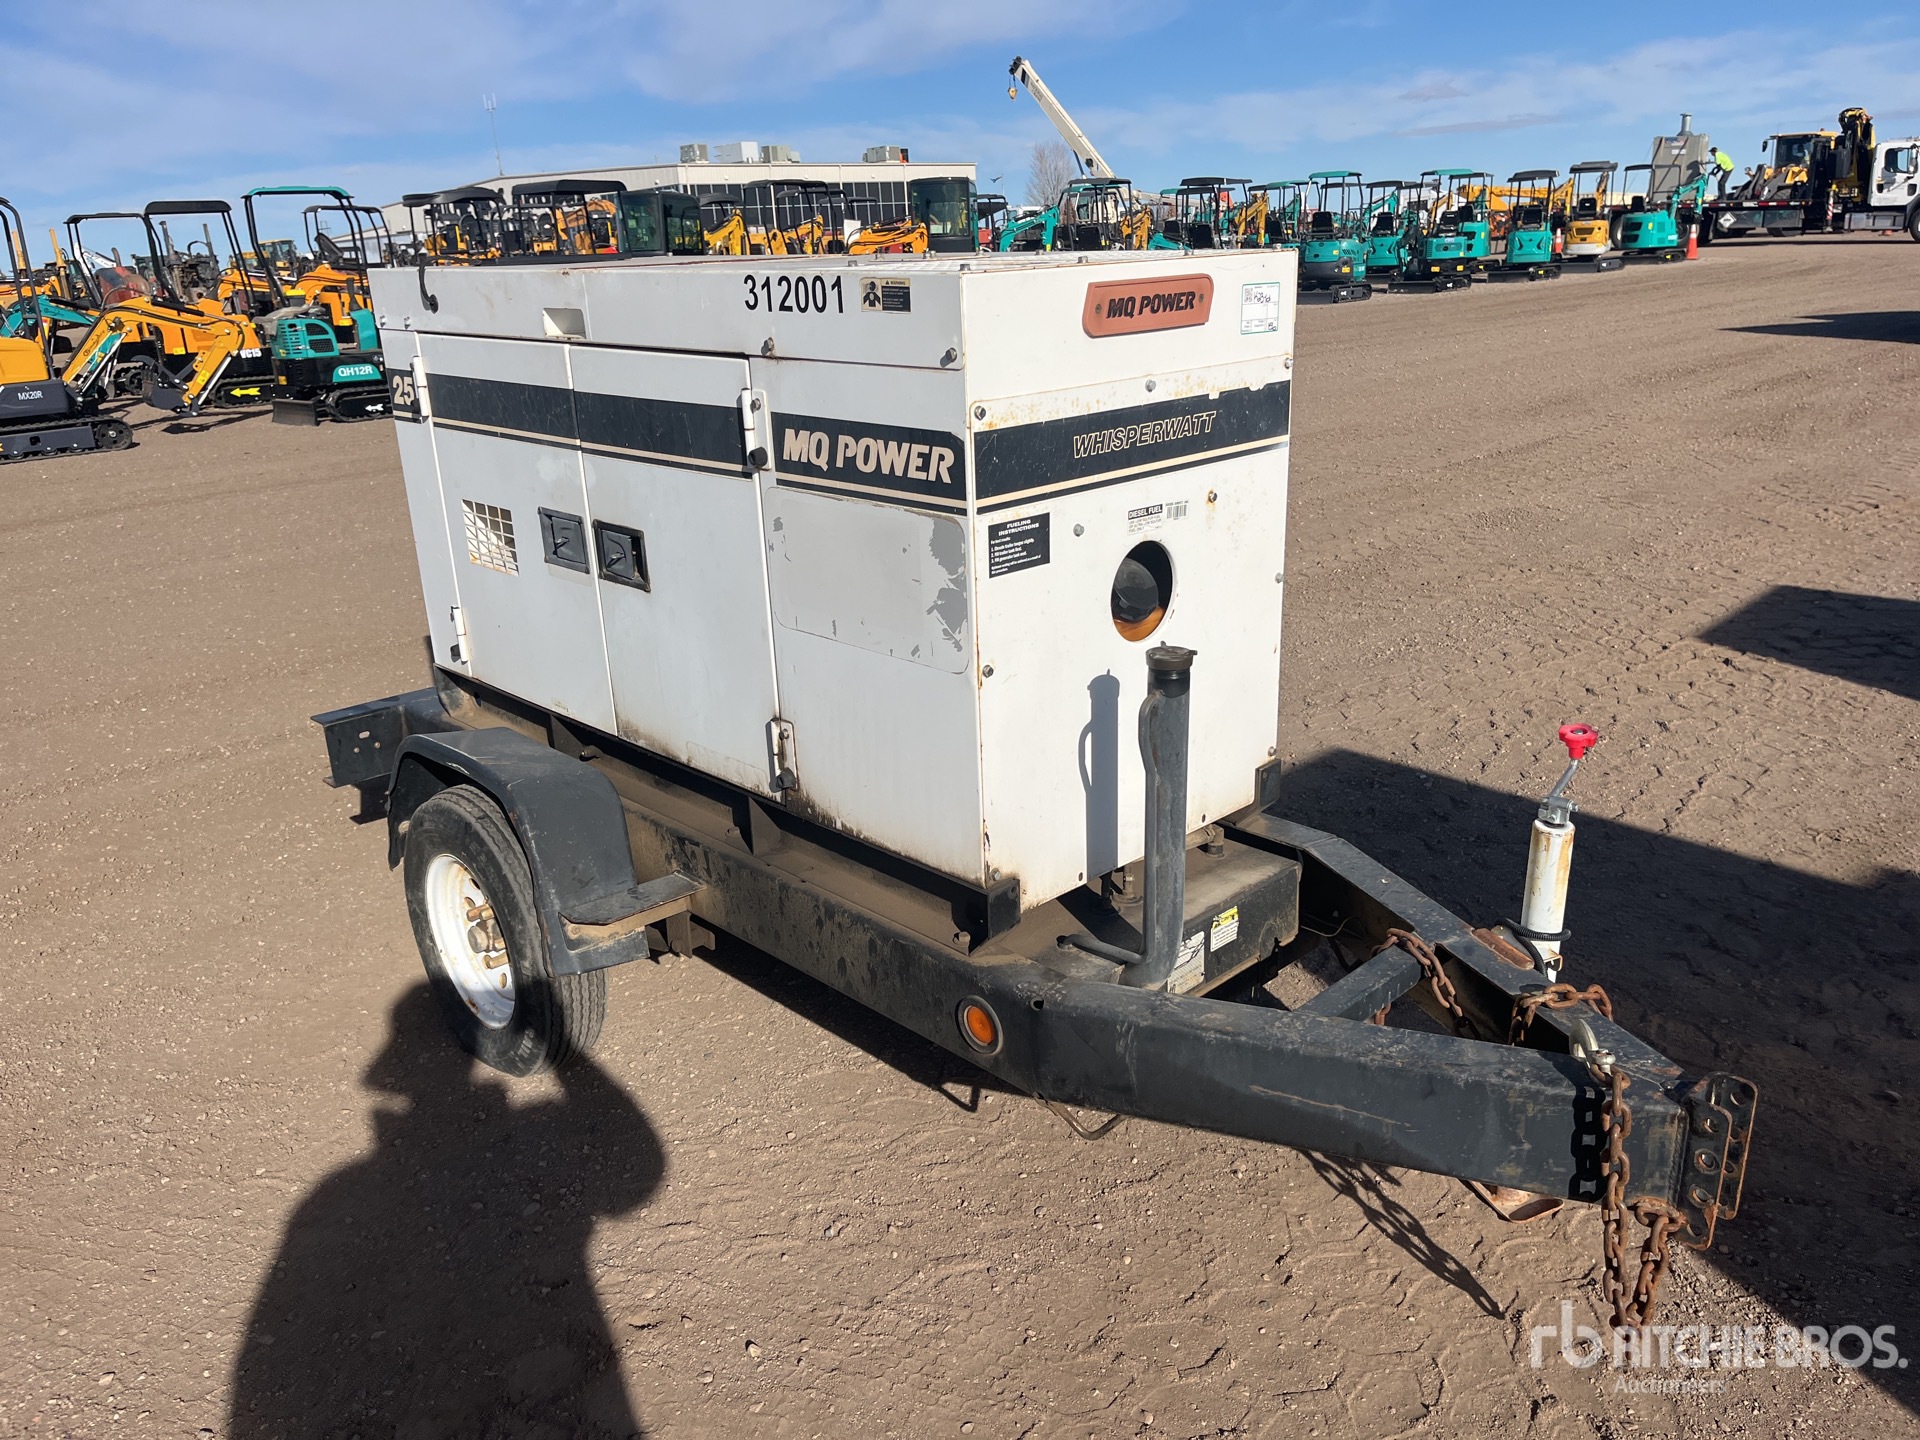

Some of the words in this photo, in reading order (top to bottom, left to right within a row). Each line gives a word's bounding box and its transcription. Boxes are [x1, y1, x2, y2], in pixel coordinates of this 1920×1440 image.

[743, 274, 843, 313] 312001
[1106, 296, 1136, 319] MQ
[1138, 291, 1196, 316] POWER
[338, 365, 373, 377] QH12R
[17, 390, 43, 400] MX20R
[392, 375, 415, 406] 25
[1073, 410, 1216, 459] WHISPERWATT
[782, 428, 830, 472] MQ
[835, 434, 955, 484] POWER
[1128, 509, 1148, 518] DIESEL
[1149, 506, 1162, 514] FUEL
[998, 523, 1039, 536] INSTRUCTIONS
[1006, 519, 1031, 528] FUELING
